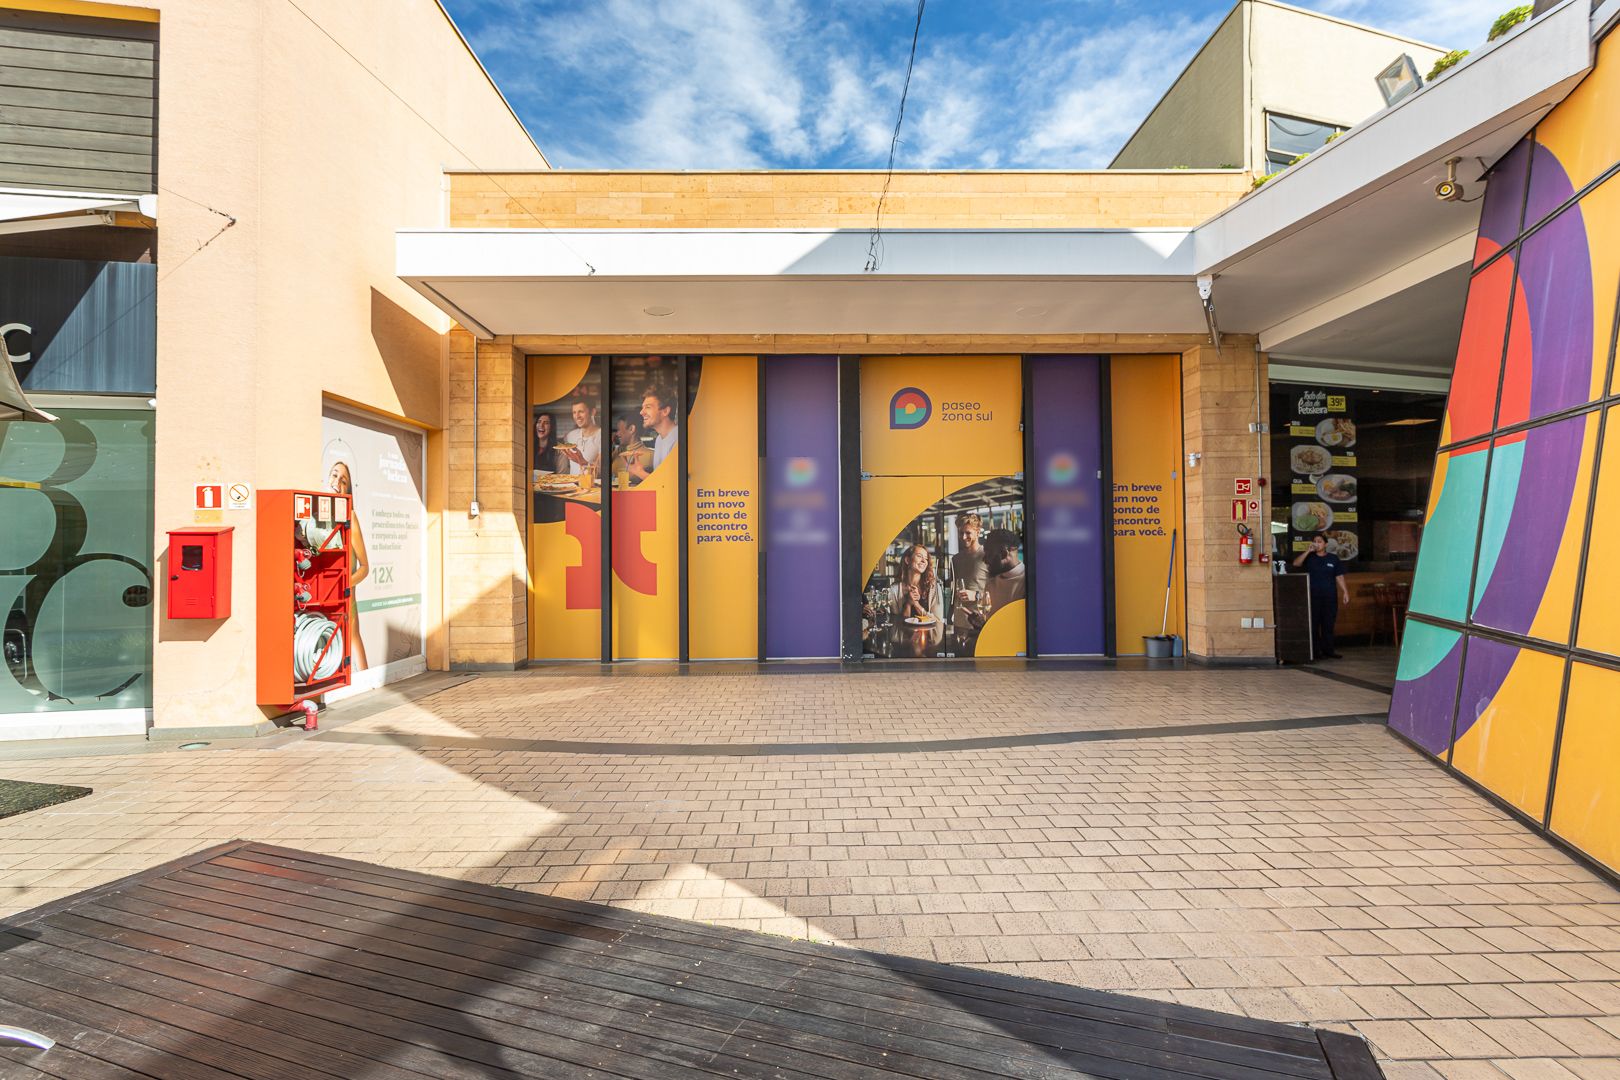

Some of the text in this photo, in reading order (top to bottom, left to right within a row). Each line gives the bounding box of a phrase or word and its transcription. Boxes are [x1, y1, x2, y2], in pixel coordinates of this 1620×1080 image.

[942, 402, 981, 412] paseo
[942, 411, 993, 421] zona sul
[1131, 483, 1162, 491] breve
[697, 489, 750, 497] Em breve
[1146, 505, 1160, 513] de
[697, 511, 748, 522] ponto de
[697, 522, 748, 531] encontro
[1138, 526, 1166, 536] você.
[697, 532, 754, 544] para você.
[372, 566, 394, 585] 12X
